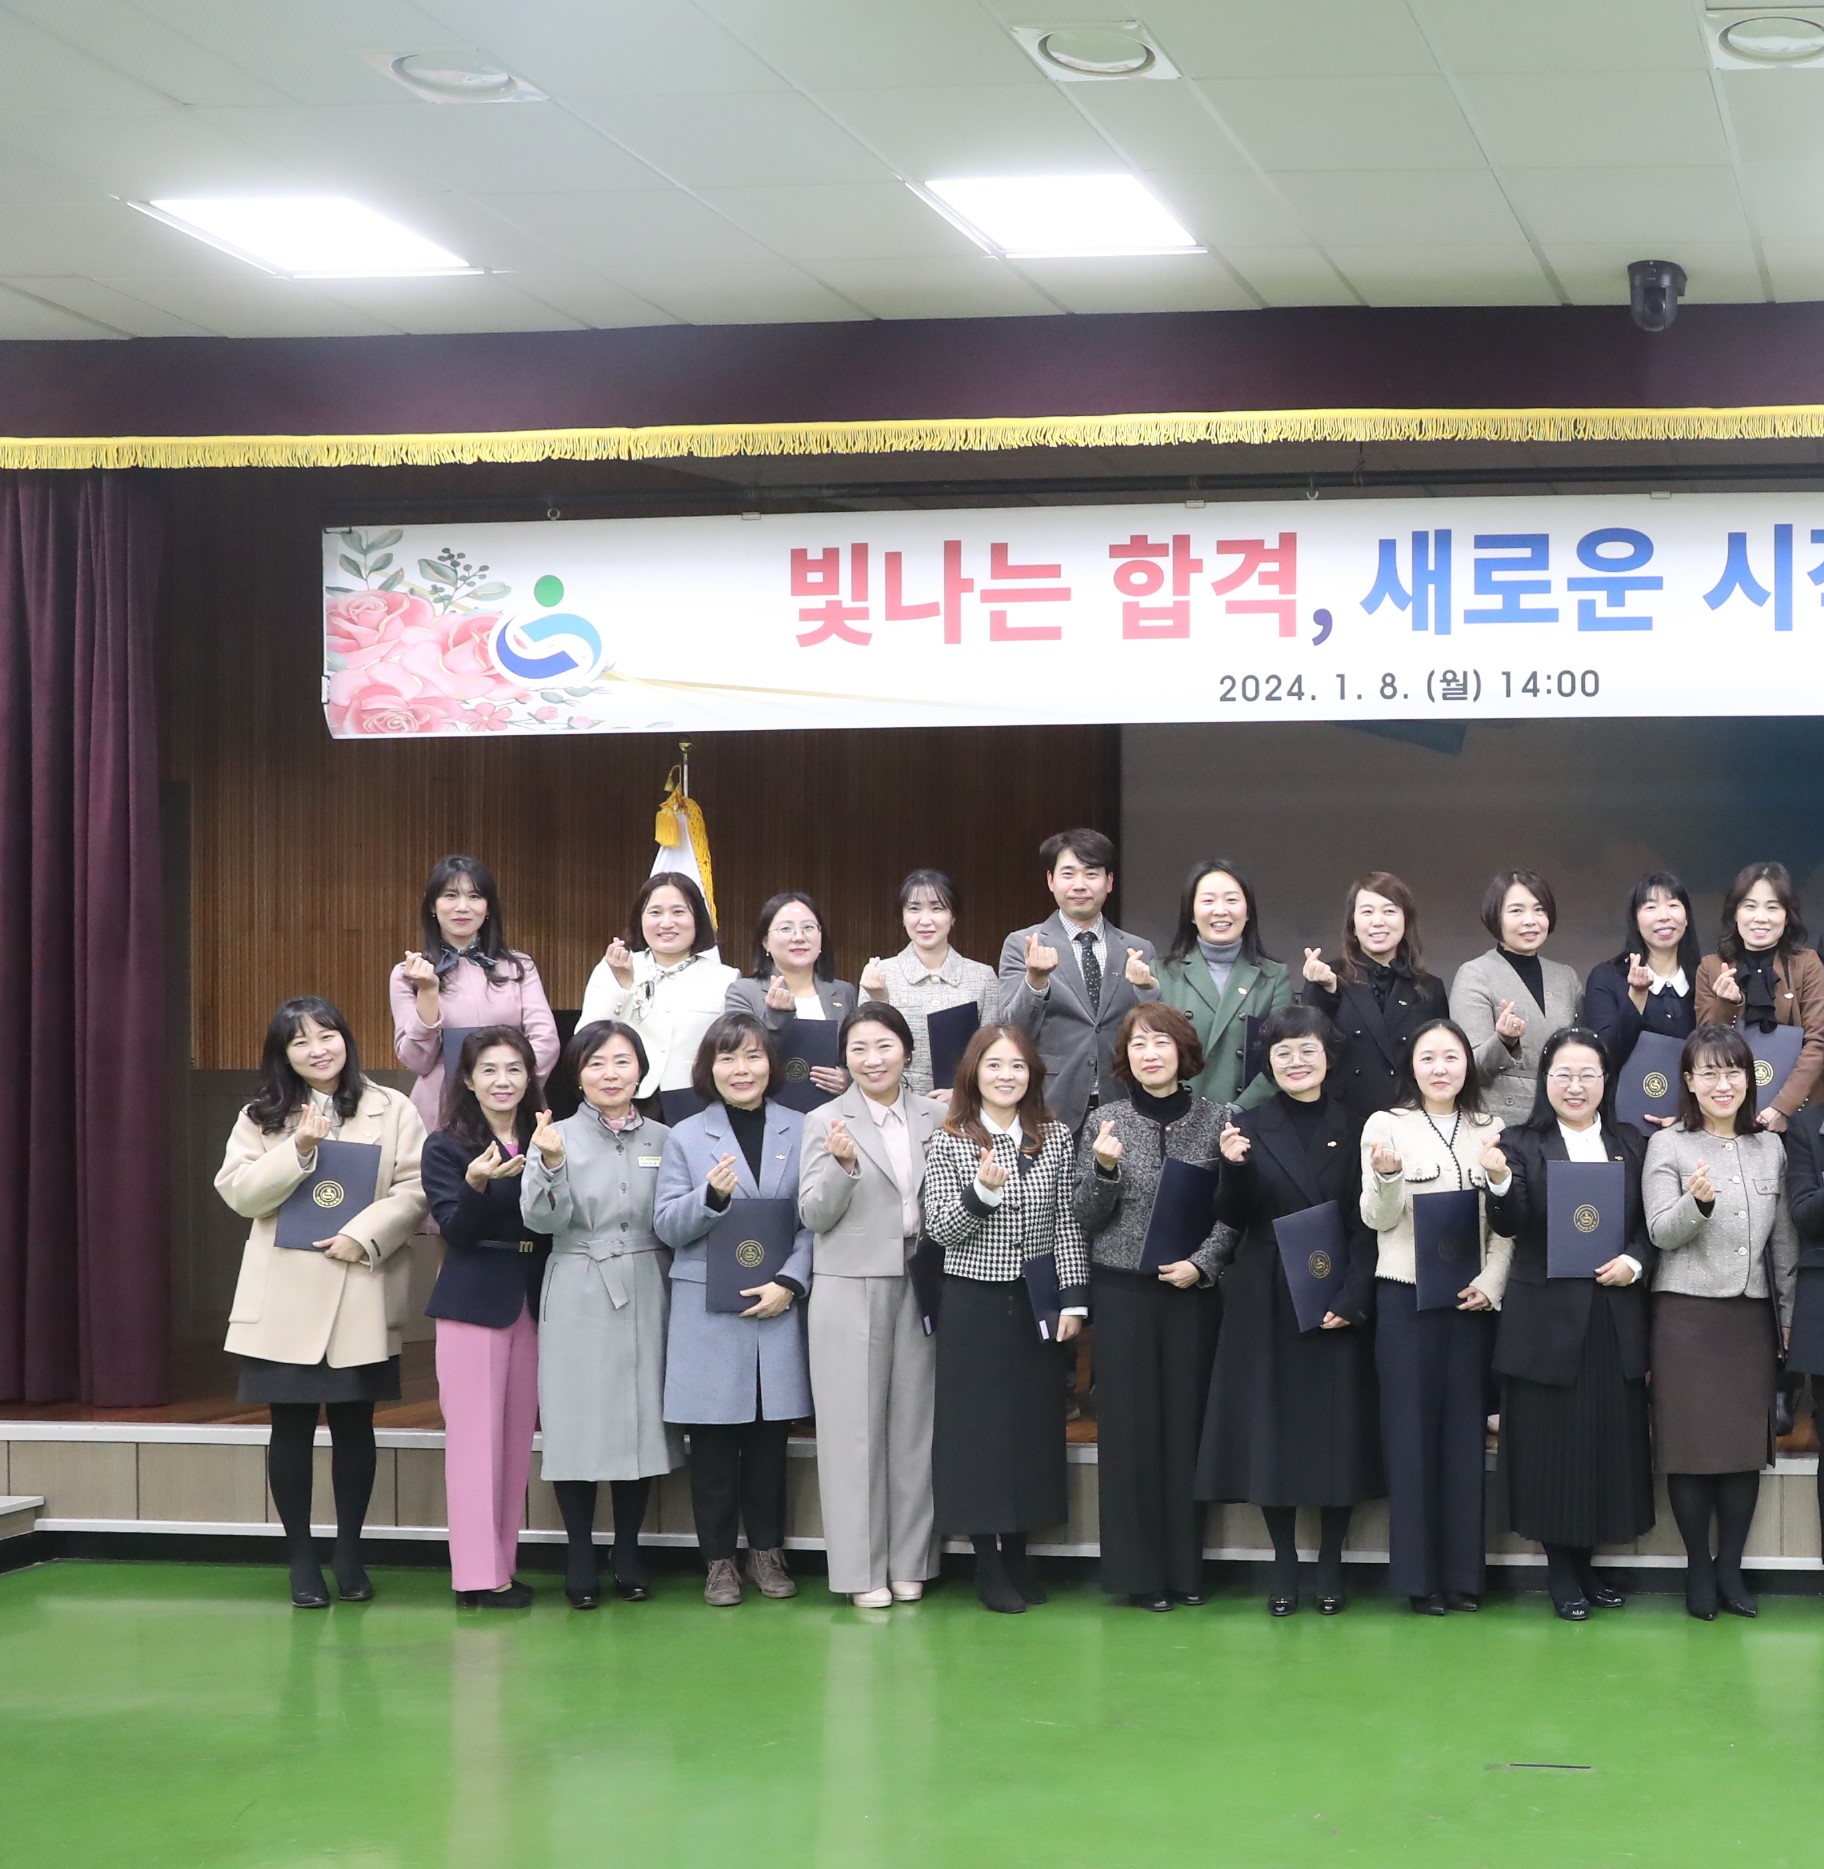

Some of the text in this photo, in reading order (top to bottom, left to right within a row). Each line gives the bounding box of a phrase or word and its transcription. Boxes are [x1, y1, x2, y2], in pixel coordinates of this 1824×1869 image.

[788, 541, 1072, 648] 빛나는
[1109, 532, 1333, 647] 합격,
[1360, 527, 1664, 636] 새로운
[1219, 668, 1600, 704] 2024. 1. 8. (월) 14:00
